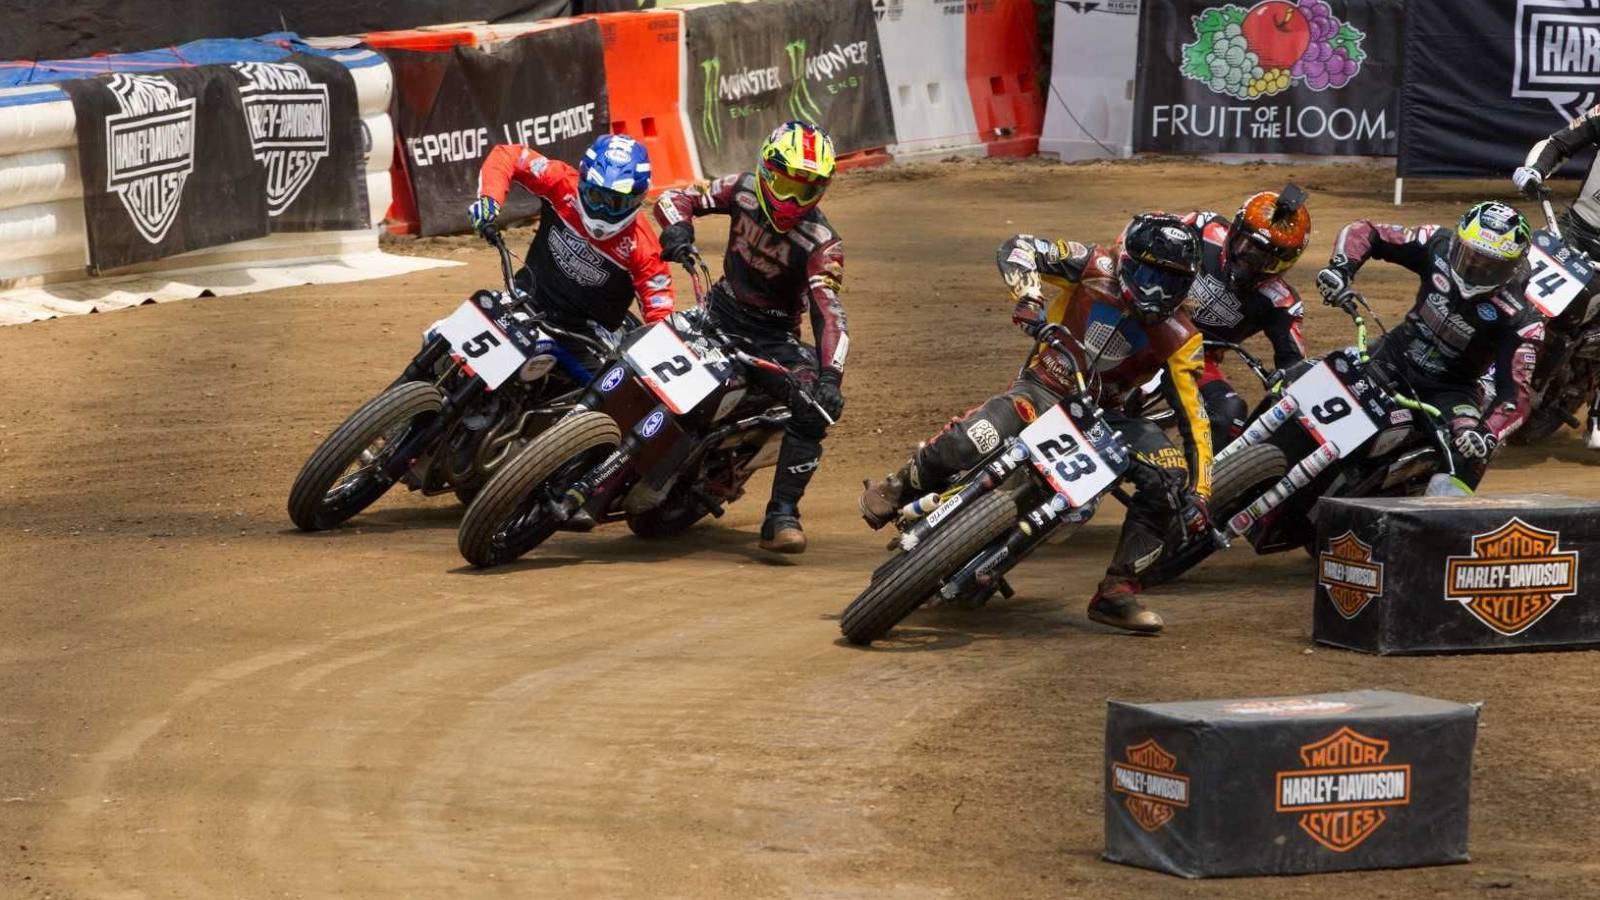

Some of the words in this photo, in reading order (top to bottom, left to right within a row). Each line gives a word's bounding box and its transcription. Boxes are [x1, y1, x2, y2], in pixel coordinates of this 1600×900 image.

[719, 66, 782, 101] MONSTER
[504, 102, 594, 146] LIFEPROOF
[1152, 104, 1251, 138] FRUIT
[1255, 106, 1279, 122] OF
[1250, 123, 1280, 139] THE
[407, 128, 488, 166] EPROOF
[462, 330, 501, 358] 5
[651, 355, 692, 383] 2
[1311, 396, 1352, 425] 9
[970, 428, 990, 454] PLATES
[977, 419, 999, 447] PRO
[1037, 433, 1097, 482] 23
[1150, 448, 1182, 461] LIGH
[1486, 533, 1545, 557] MOTOR
[1455, 562, 1569, 589] HARLEY-DAVIDSON
[1481, 595, 1542, 622] CYCLES
[1132, 746, 1171, 771] MOTOR
[1312, 735, 1378, 766] MOTOR
[1115, 766, 1186, 801] HARLEY-DAVIDSON
[1282, 771, 1405, 805] HARLEY-DAVIDSON
[1310, 811, 1375, 846] CYCLES
